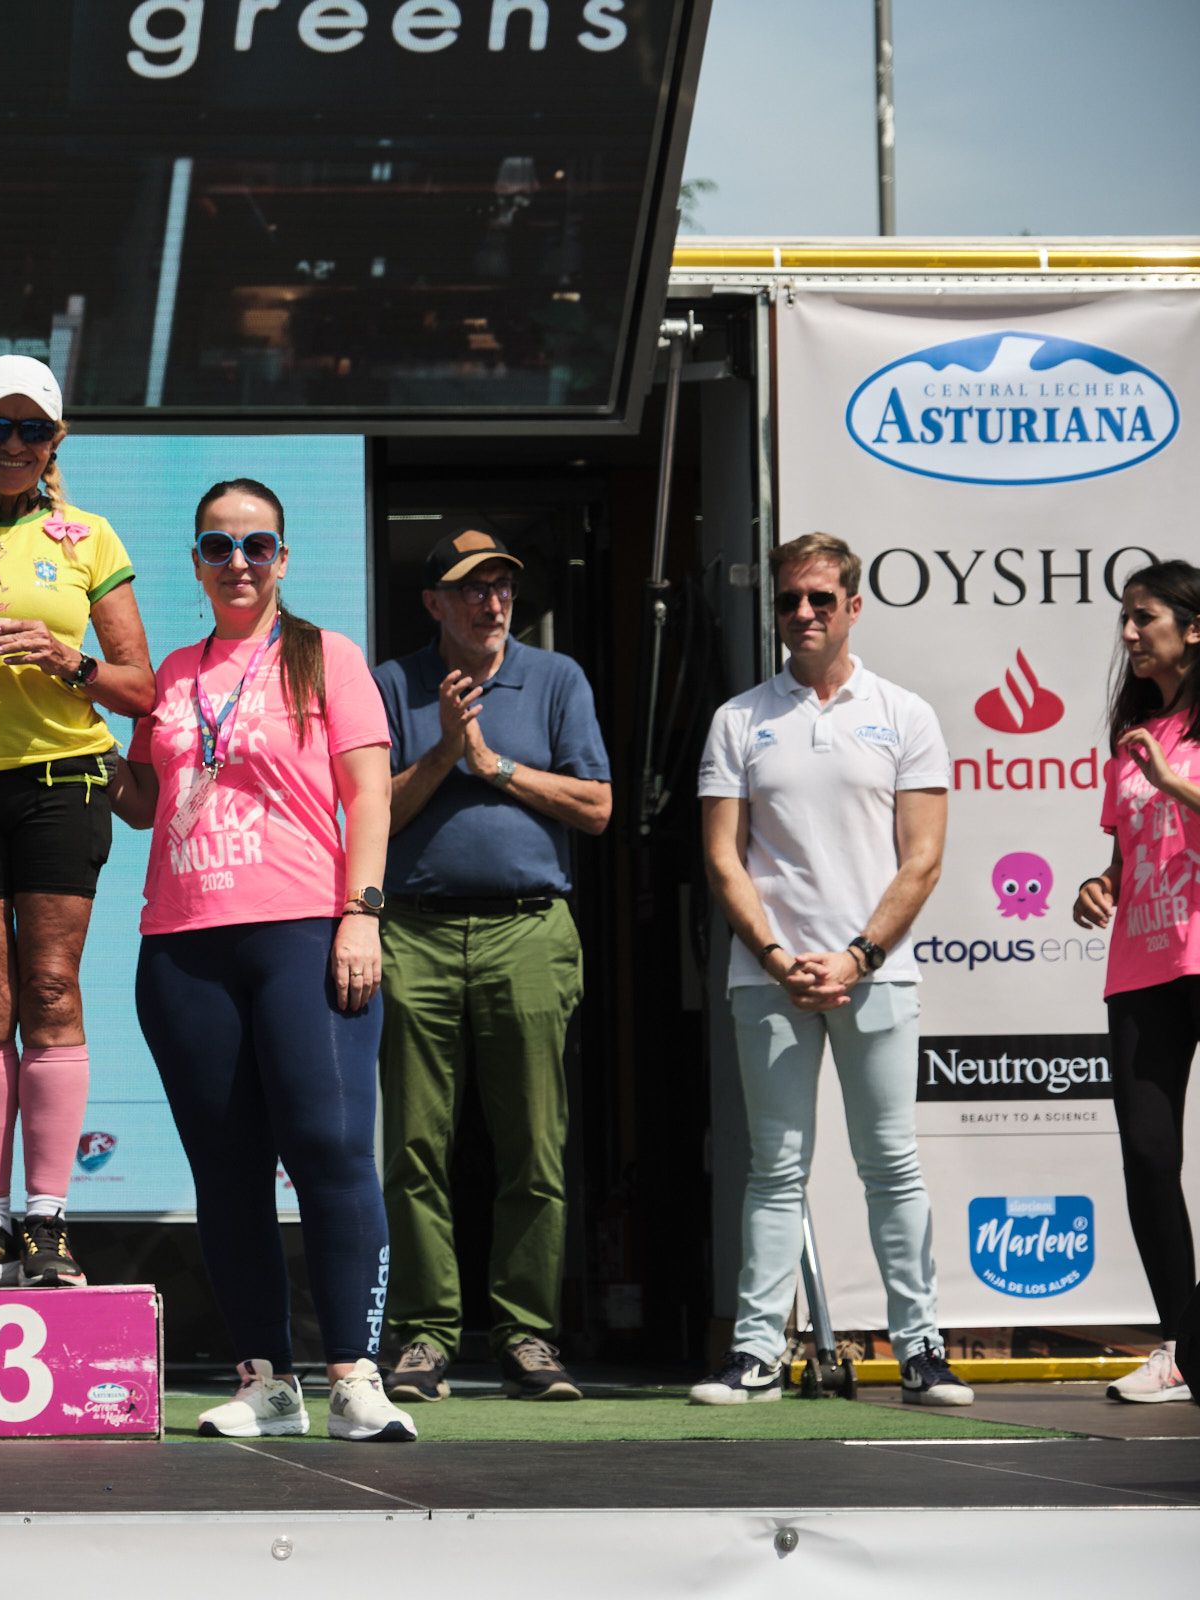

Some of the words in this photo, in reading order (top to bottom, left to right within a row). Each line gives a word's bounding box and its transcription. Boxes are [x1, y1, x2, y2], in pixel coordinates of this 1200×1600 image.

[127, 0, 628, 79] greens
[923, 383, 1029, 397] CENTRAL
[1039, 383, 1146, 397] LECHERA
[872, 386, 1156, 445] ASTURIANA
[868, 546, 1162, 608] OYSHO
[168, 831, 263, 876] MUJER
[200, 870, 235, 893] 2026
[1127, 895, 1189, 938] MUJER
[923, 1048, 1113, 1094] Neutrogen
[961, 1112, 1008, 1123] BEAUTY
[1014, 1112, 1029, 1122] TO
[1033, 1112, 1042, 1122] A
[1045, 1110, 1098, 1122] SCIENCE
[976, 1217, 1088, 1272] Marlene
[366, 1244, 390, 1355] adidas
[983, 1269, 1006, 1289] HIJA
[1008, 1282, 1023, 1294] DE
[1025, 1284, 1047, 1294] LOS
[1048, 1270, 1080, 1292] ALPES
